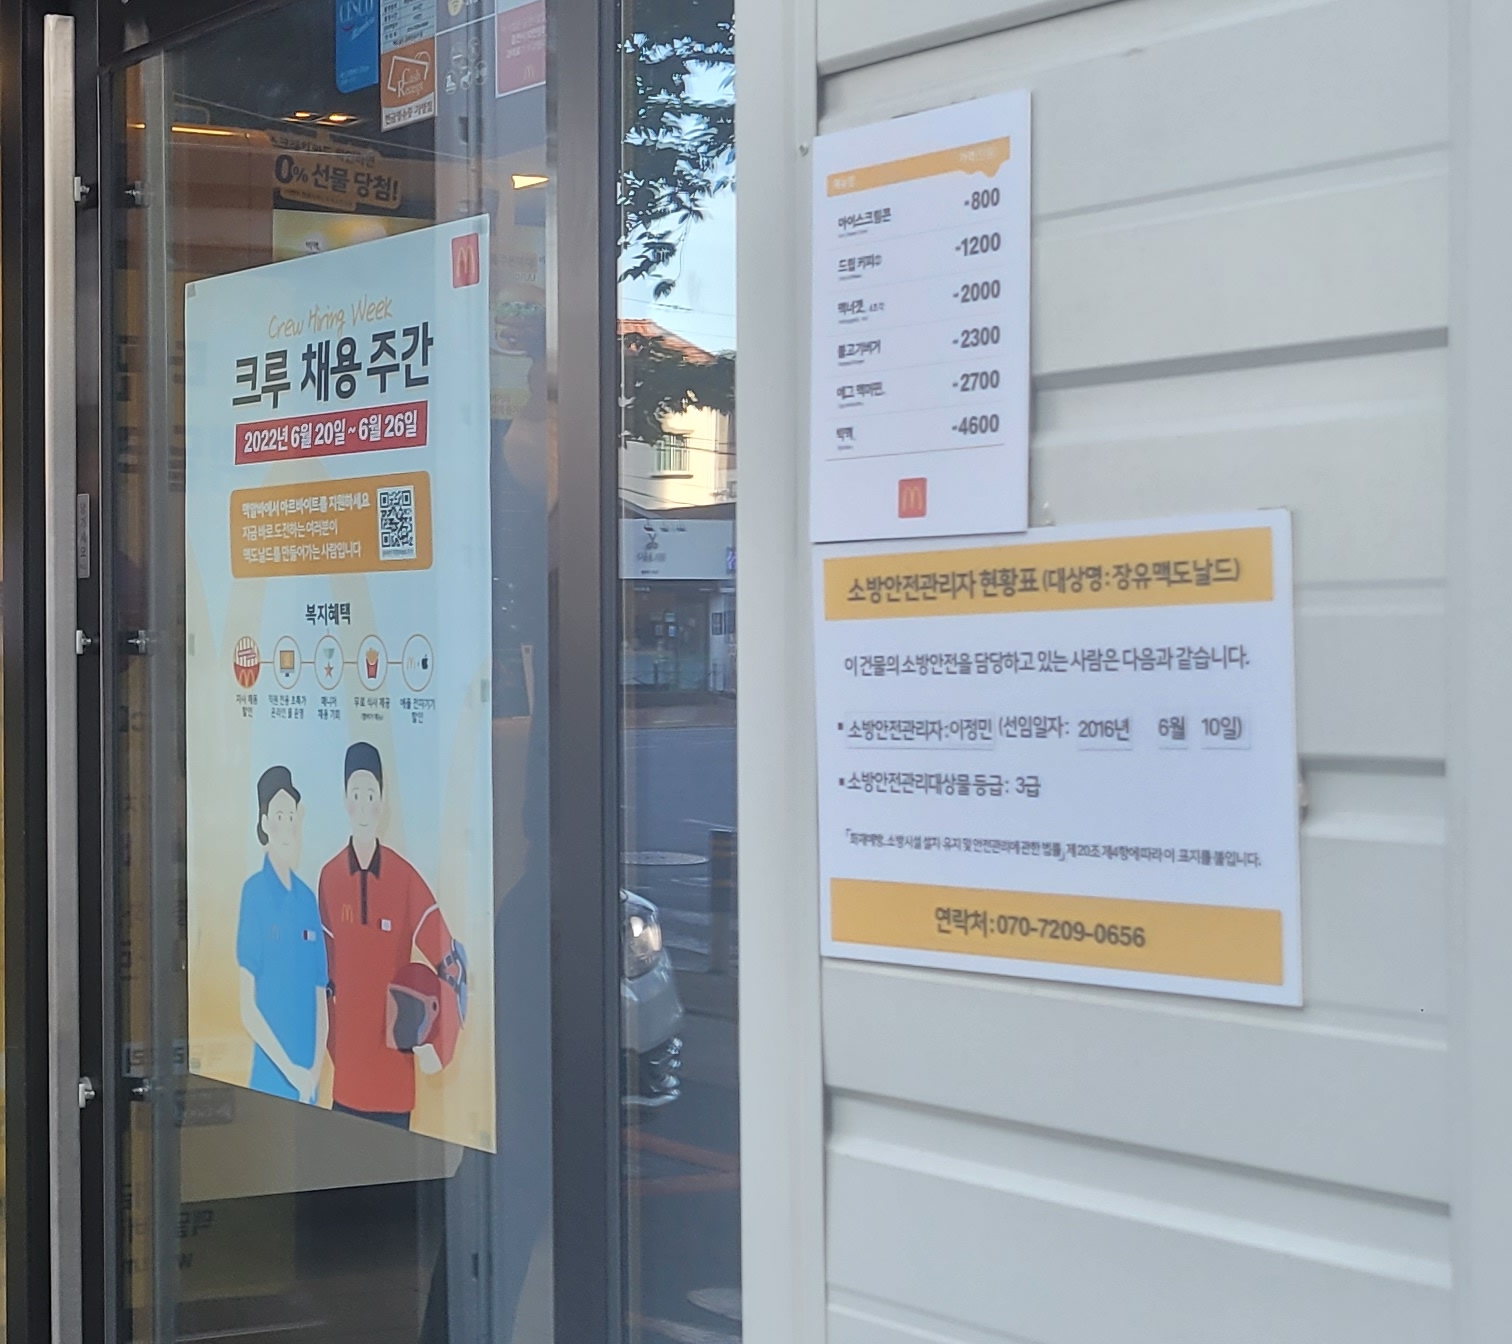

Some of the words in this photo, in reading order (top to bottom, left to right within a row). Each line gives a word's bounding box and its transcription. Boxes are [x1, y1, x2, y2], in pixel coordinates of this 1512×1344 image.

[312, 162, 349, 194] 선물
[354, 171, 399, 202] 당첨!
[268, 314, 304, 340] Crew
[351, 294, 393, 327] Week
[232, 349, 291, 410] 크루
[301, 337, 363, 402] 채용
[366, 321, 434, 394] 주간
[244, 424, 289, 454] 2022년
[290, 422, 313, 449] 6월
[314, 418, 347, 447] 20일
[358, 413, 382, 442] 6월
[384, 409, 418, 438] 26일
[847, 569, 976, 604] 소방안전관리자
[978, 566, 1040, 598] 현황표
[305, 602, 351, 626] 복지혜택
[844, 656, 858, 676] 이
[859, 654, 900, 677] 건물의
[901, 652, 973, 676] 소방안전을
[975, 651, 1036, 674] 담당하고
[1037, 649, 1069, 673] 있는
[1070, 647, 1119, 672] 사람은
[1121, 646, 1174, 671] 다음과
[1176, 643, 1251, 670] 같습니다.
[1077, 717, 1131, 741] 2016년
[1157, 715, 1186, 741] 6월
[1200, 715, 1243, 741] 10일)
[847, 771, 971, 797] 소방안전관리대상물
[1015, 775, 1042, 798] 3급
